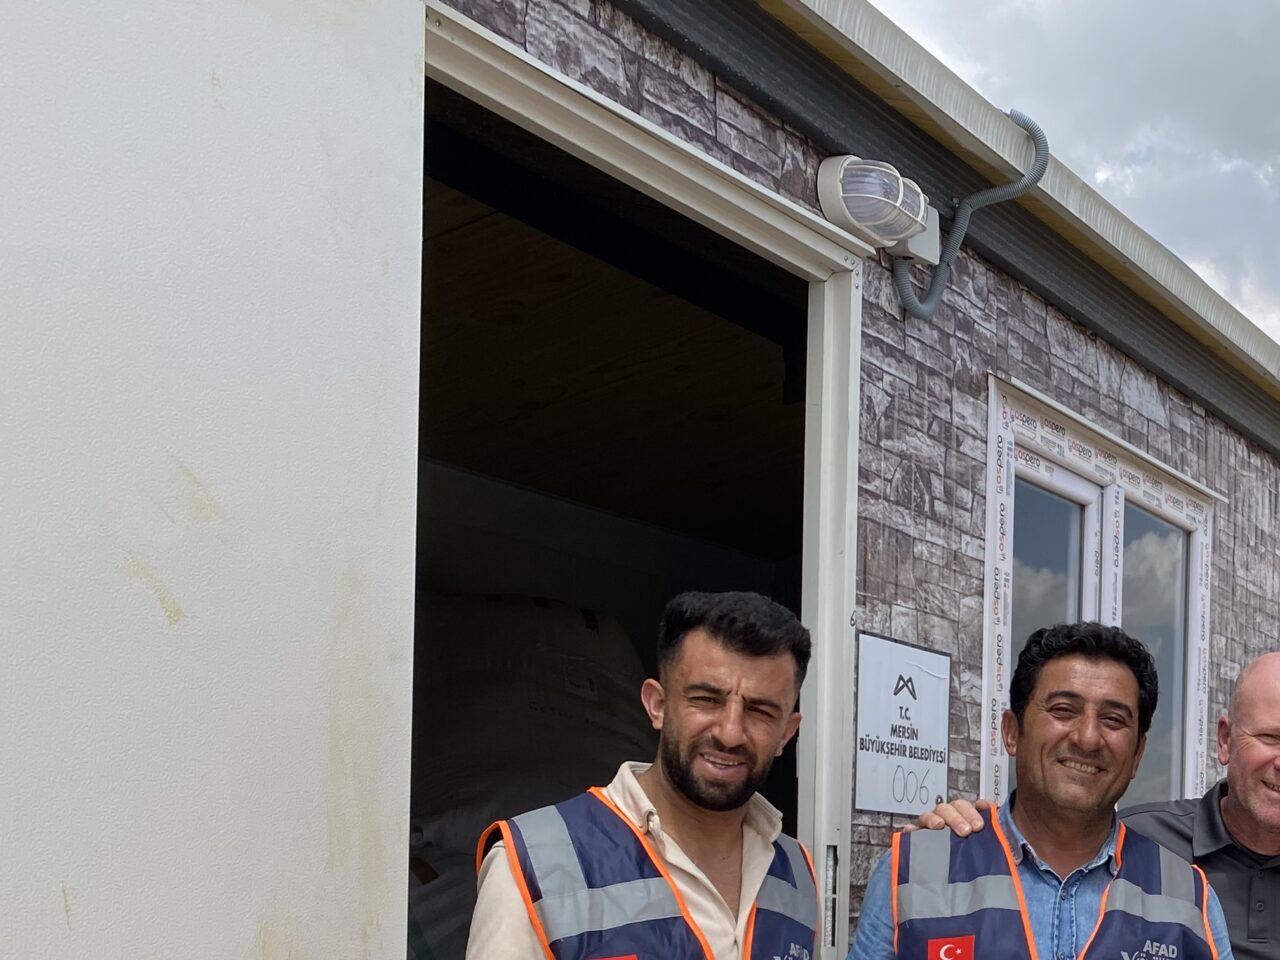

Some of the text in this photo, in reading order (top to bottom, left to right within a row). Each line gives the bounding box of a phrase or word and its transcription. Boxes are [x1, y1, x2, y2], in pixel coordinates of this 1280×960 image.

[898, 706, 911, 721] T.C.
[890, 723, 919, 741] MERSİN
[859, 734, 946, 764] BÜYÜKŞEHİR BELEDİYESİ
[892, 764, 931, 805] 006
[1143, 940, 1178, 958] AFAD
